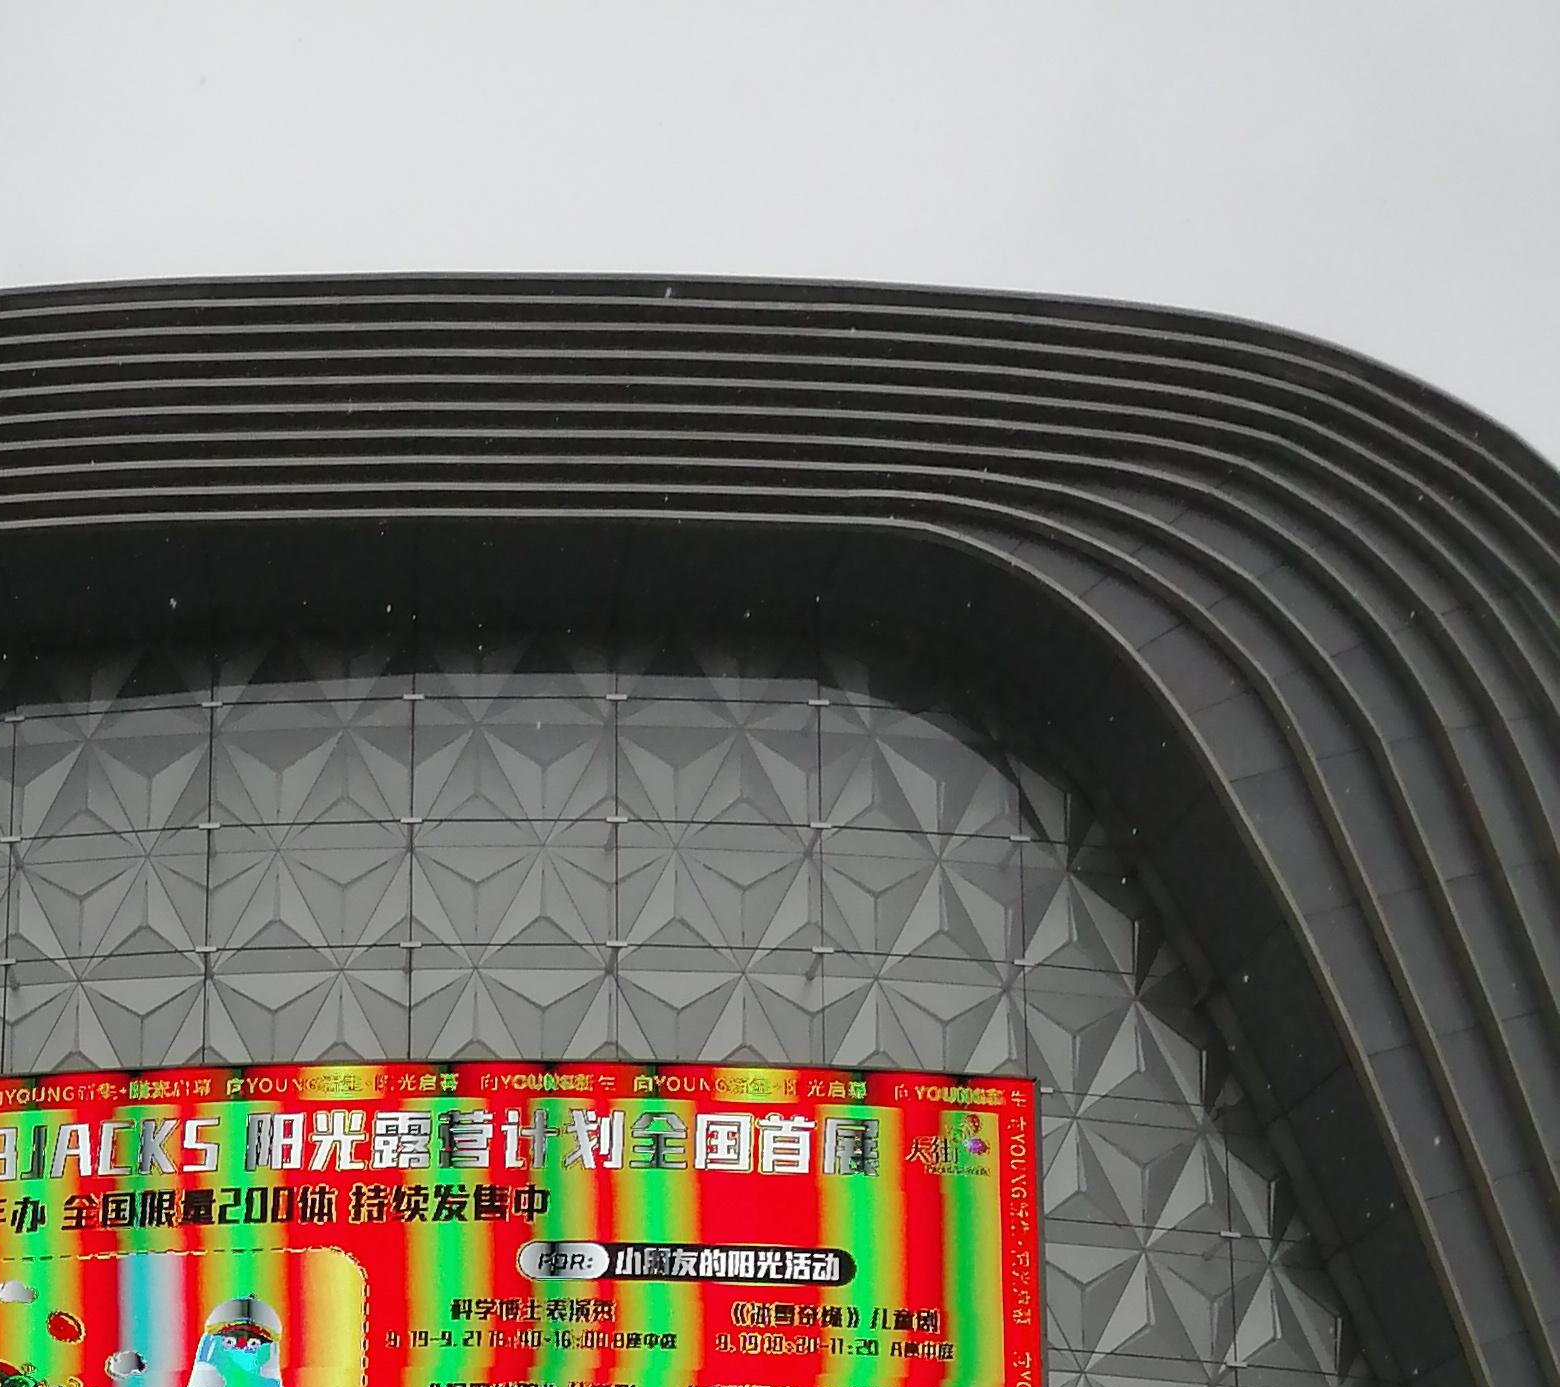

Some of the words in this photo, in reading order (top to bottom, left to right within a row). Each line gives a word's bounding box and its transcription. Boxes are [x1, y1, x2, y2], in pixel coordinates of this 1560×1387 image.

[245, 1107, 880, 1177] 阳光露营计划全国首展
[61, 1184, 337, 1233] 全国限量200体
[350, 1184, 551, 1228] 持续发售中
[615, 1246, 841, 1282] 小朋友的阳光活动
